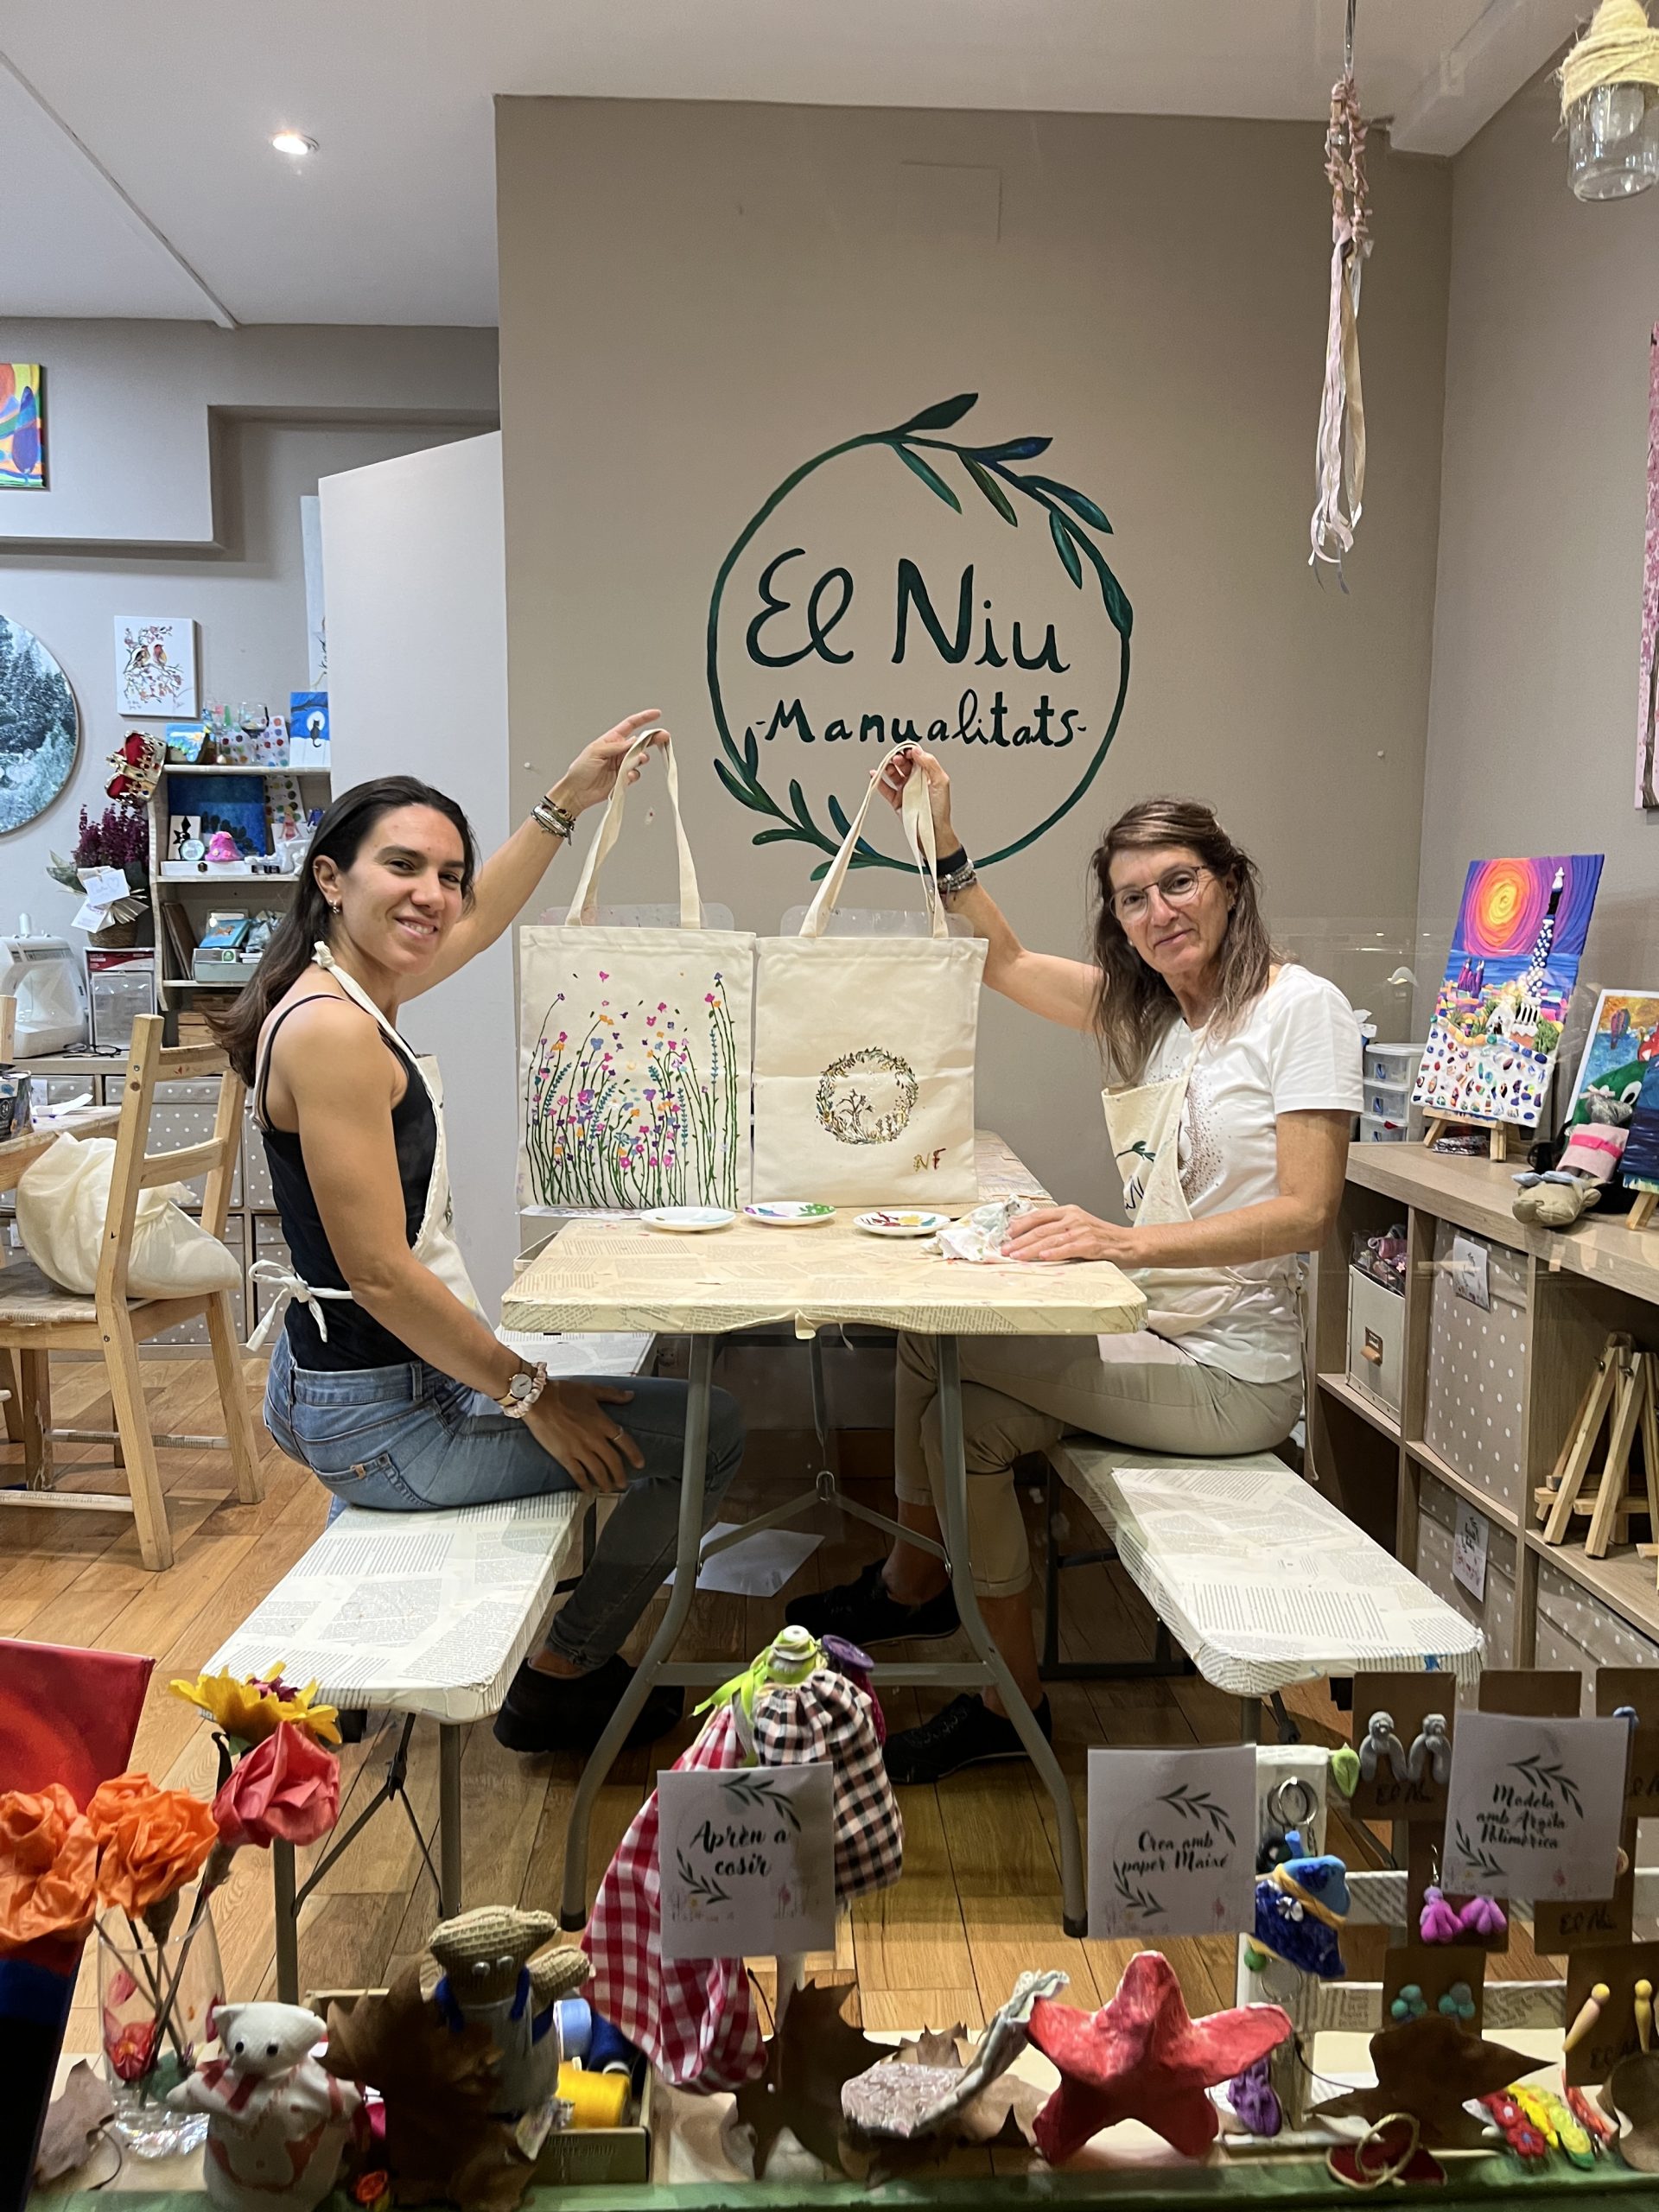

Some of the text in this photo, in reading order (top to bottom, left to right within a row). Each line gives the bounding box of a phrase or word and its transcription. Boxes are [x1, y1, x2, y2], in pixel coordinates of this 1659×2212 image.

[746, 547, 1071, 674] El Niu
[1492, 1783, 1554, 1808] Modela
[773, 1828, 790, 1844] a
[1138, 1829, 1213, 1853] Crea amb
[715, 1853, 772, 1877] cosir
[1122, 1856, 1165, 1877] paper
